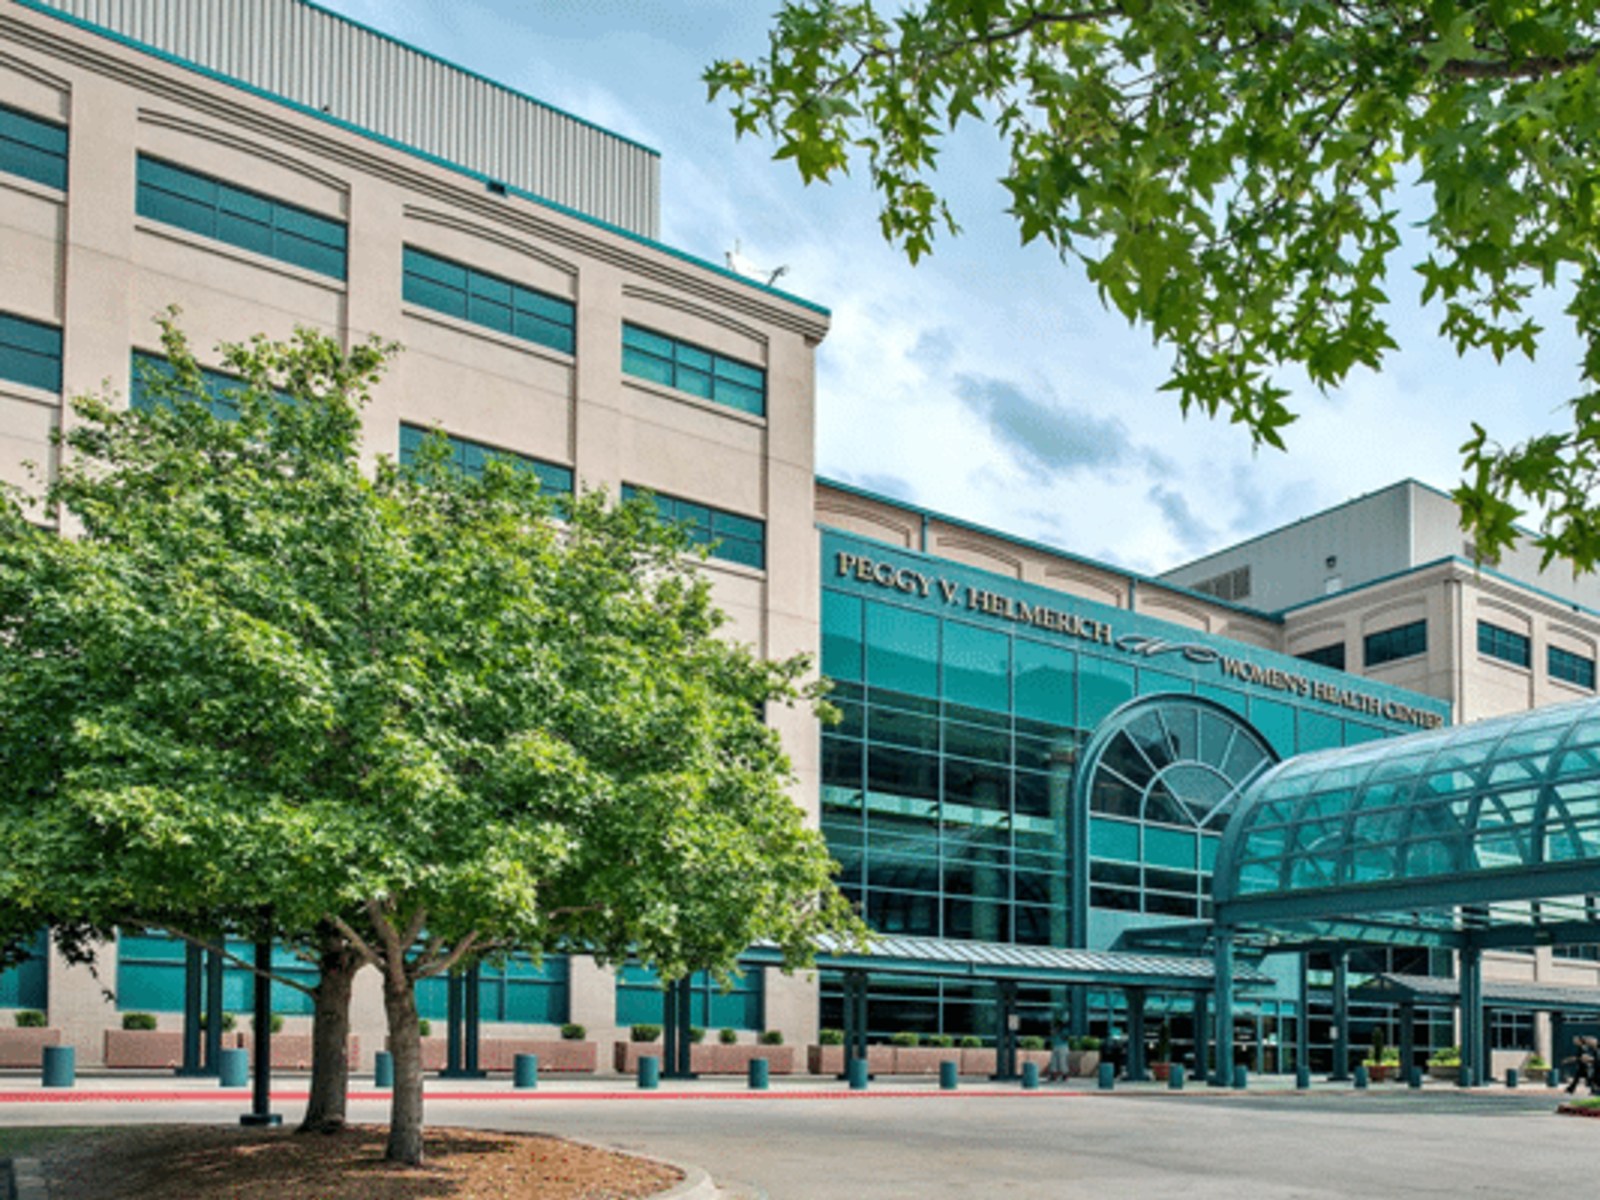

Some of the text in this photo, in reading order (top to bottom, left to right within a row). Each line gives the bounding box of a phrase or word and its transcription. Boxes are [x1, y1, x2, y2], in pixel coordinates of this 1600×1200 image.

[837, 552, 1443, 729] PEGGY V. HELMERICH WOMEN'S HEALTH CENTER
